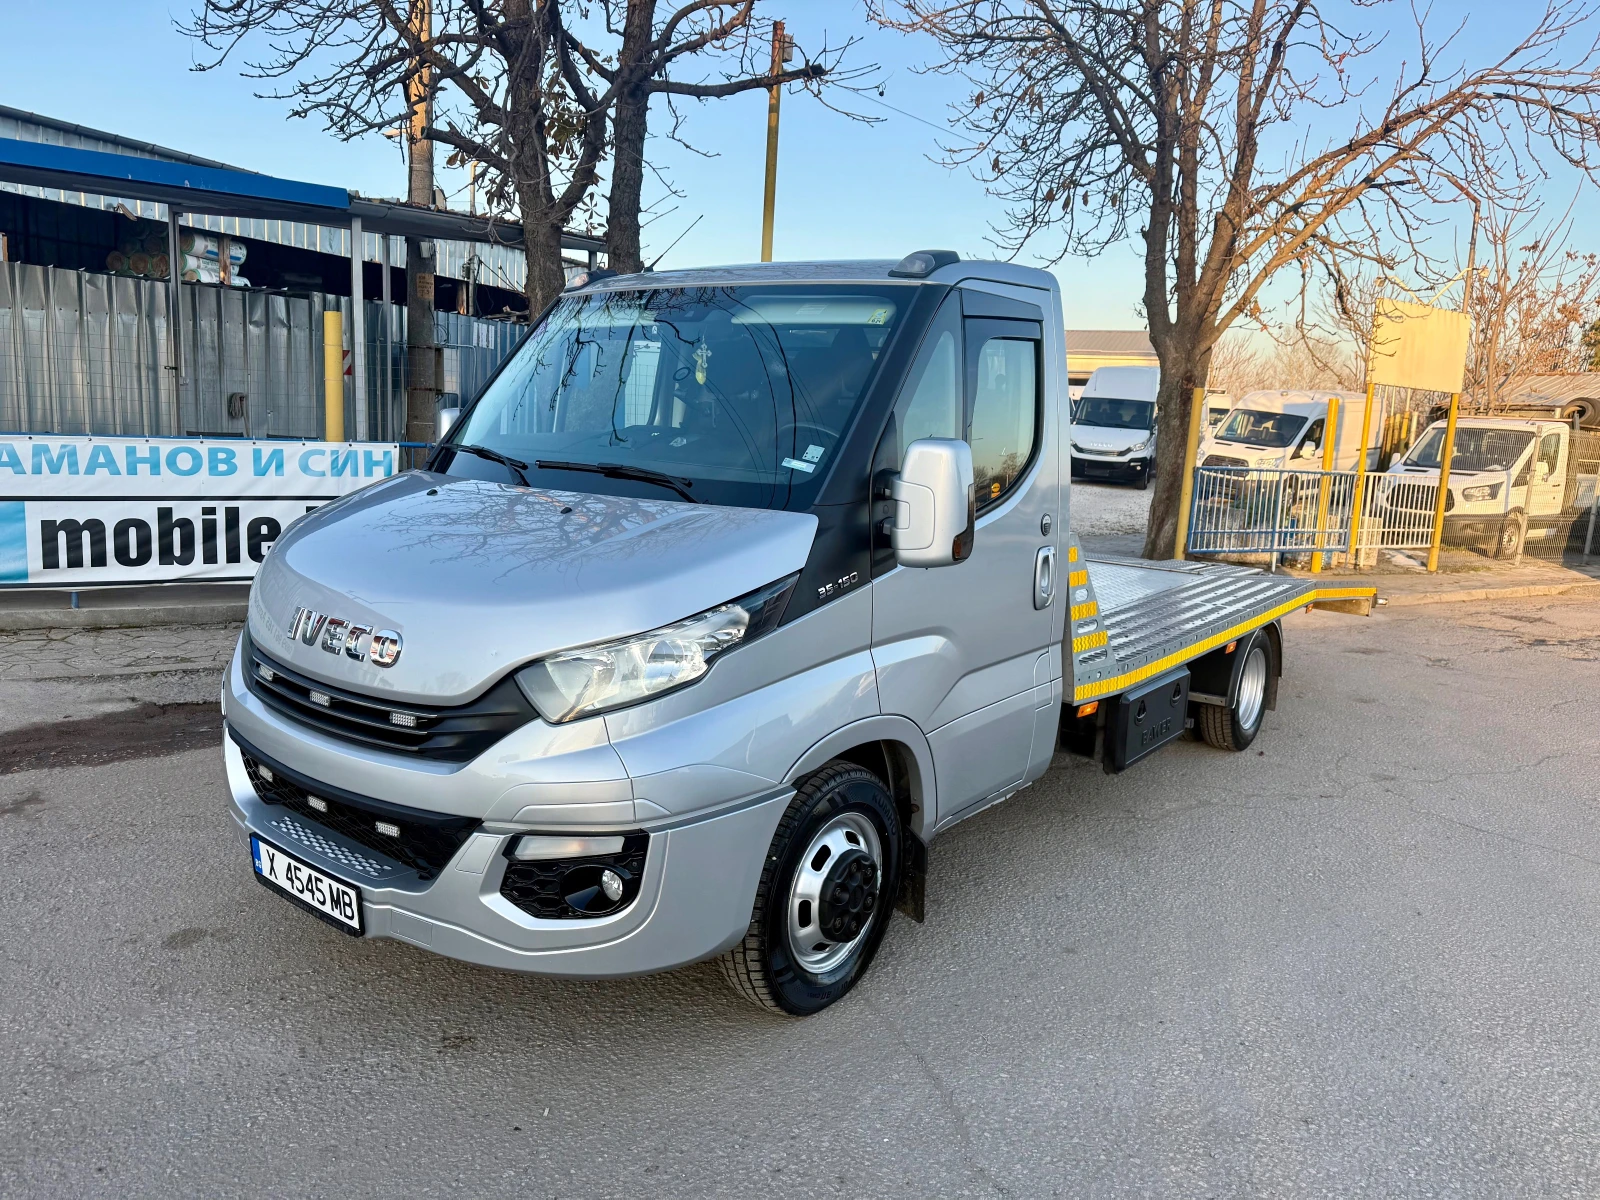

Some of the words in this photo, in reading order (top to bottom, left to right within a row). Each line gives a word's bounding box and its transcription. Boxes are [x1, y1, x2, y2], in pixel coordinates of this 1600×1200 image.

[253, 447, 285, 478] И
[298, 448, 393, 478] СИН
[41, 506, 318, 570] mobile
[817, 571, 859, 600] 35-150
[286, 606, 404, 669] IVECO
[871, 791, 897, 836] KUMHO
[266, 849, 278, 880] X
[285, 861, 327, 907] 4545
[328, 882, 355, 921] MB
